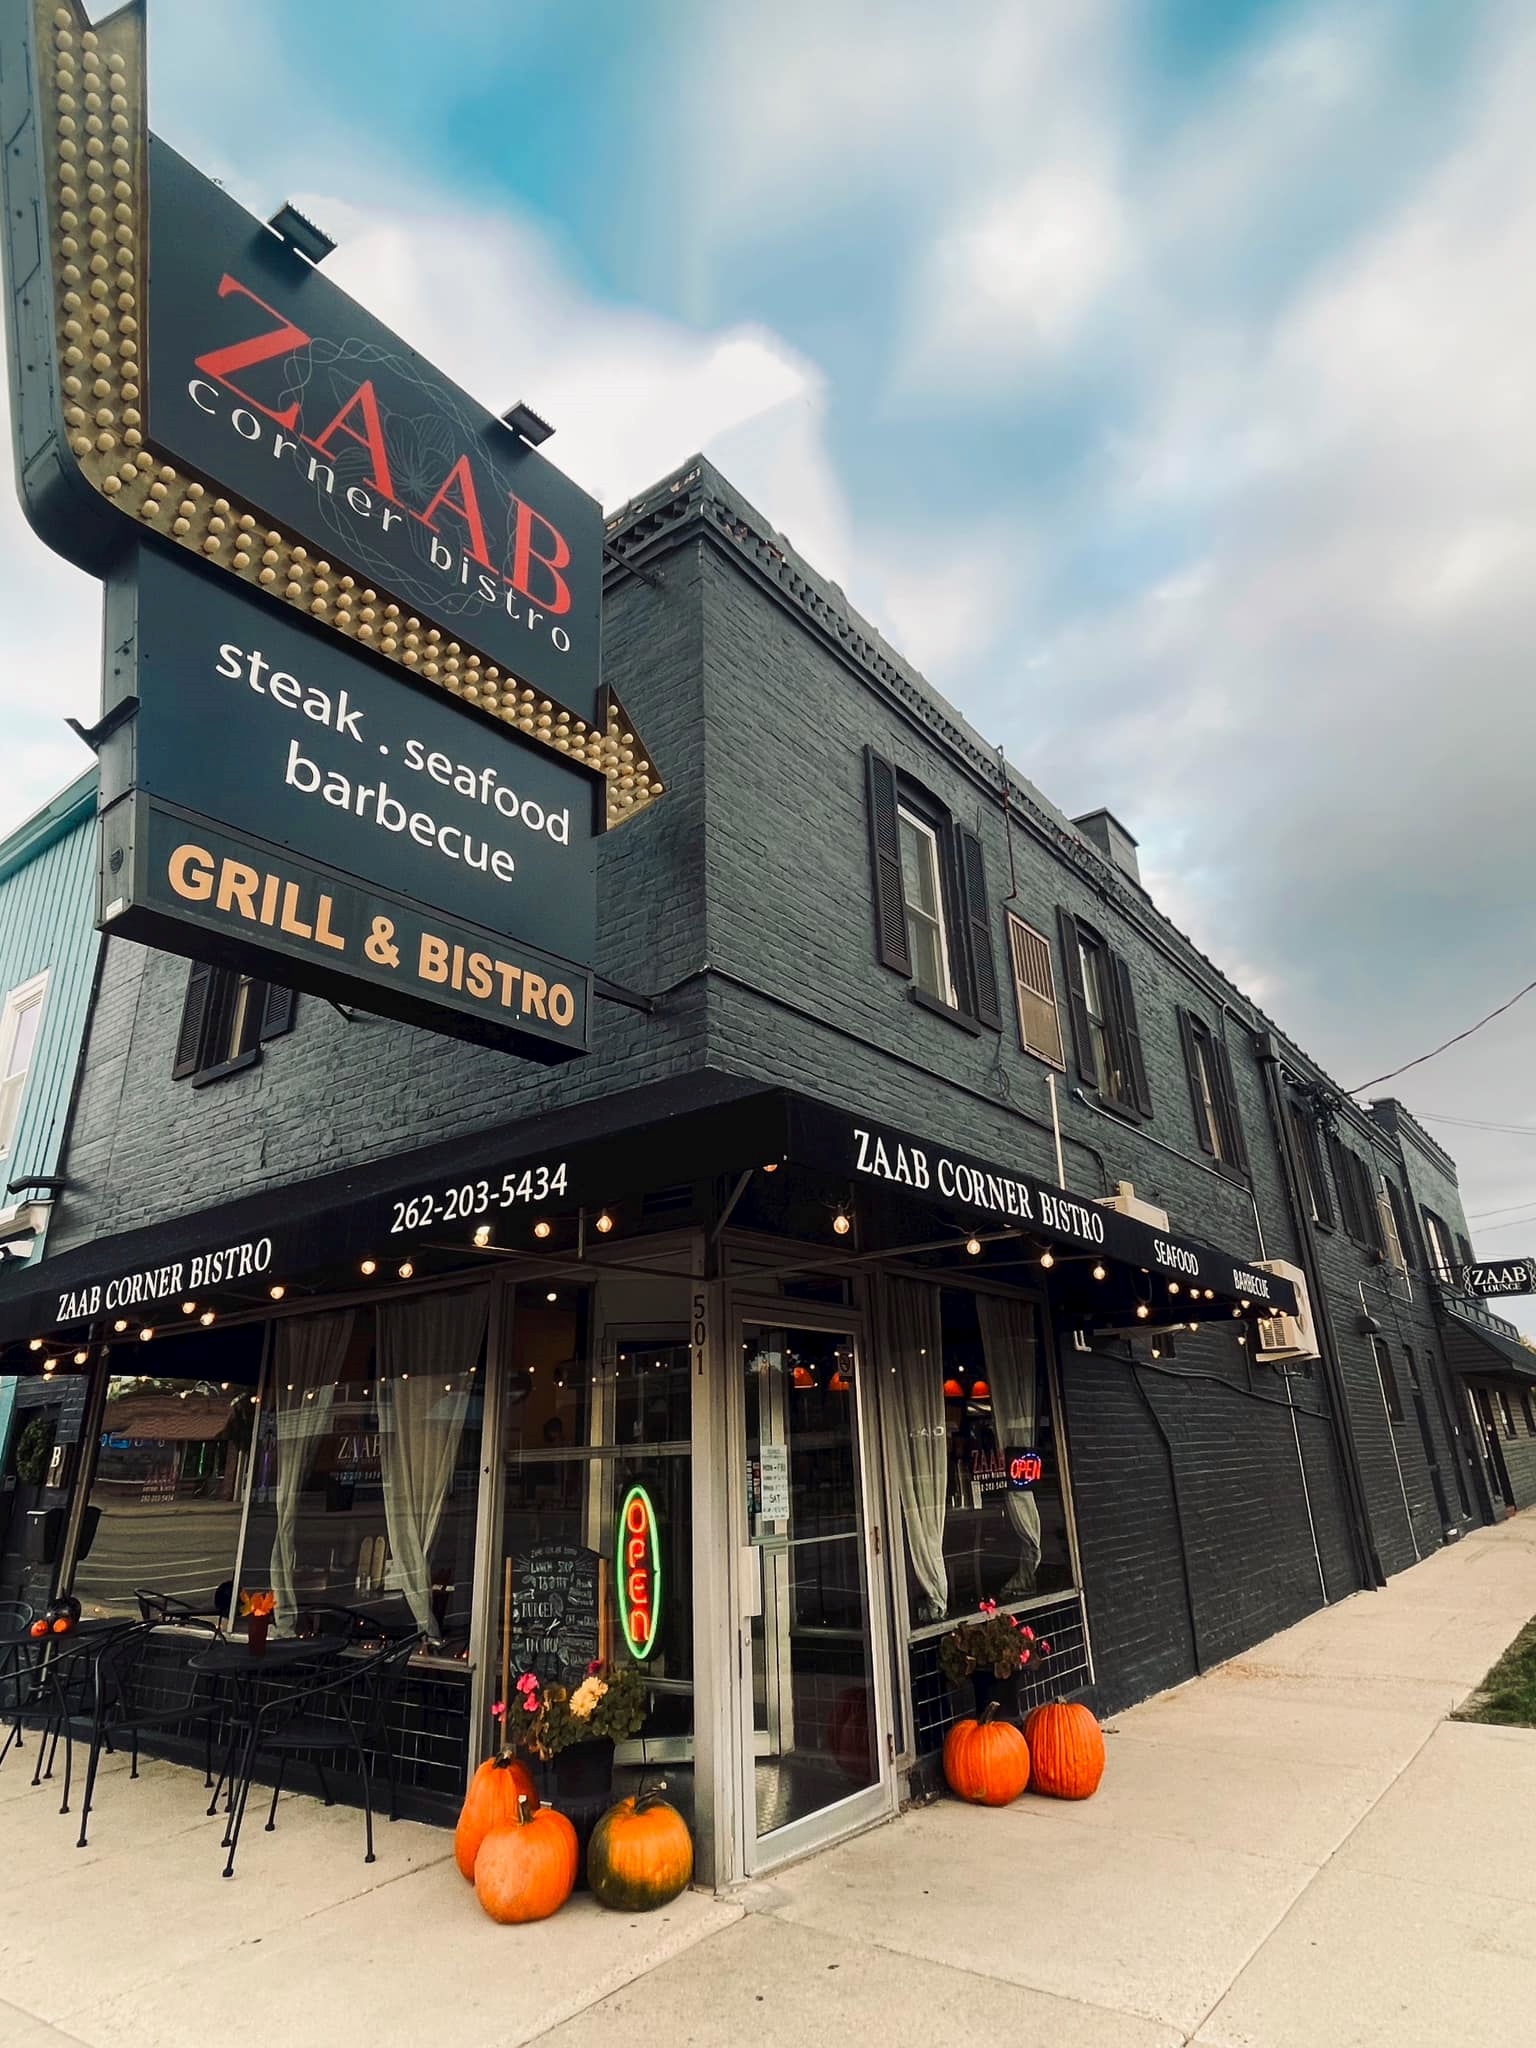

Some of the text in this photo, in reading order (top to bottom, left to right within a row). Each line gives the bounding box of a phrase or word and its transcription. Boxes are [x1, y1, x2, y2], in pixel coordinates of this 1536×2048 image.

[194, 272, 571, 615] ZAAB
[188, 379, 570, 652] corner bistro
[215, 643, 365, 742] steak
[404, 738, 569, 845] seafood
[285, 740, 515, 882] barbecue
[168, 844, 575, 1028] GRILL & BISTRO
[390, 1163, 567, 1233] 262-203-5434
[853, 1129, 1104, 1244] ZAAB CORNER BISTRO
[56, 1238, 272, 1321] ZAAB CORNER BISTRO
[1154, 1239, 1199, 1276] SEAFOOD
[1232, 1269, 1271, 1299] BARBECUE
[1471, 1266, 1527, 1286] ZAAB
[1482, 1283, 1522, 1293] LOUNGE
[693, 1294, 706, 1375] 501
[1010, 1459, 1042, 1480] OPEN
[627, 1499, 649, 1642] OPEN
